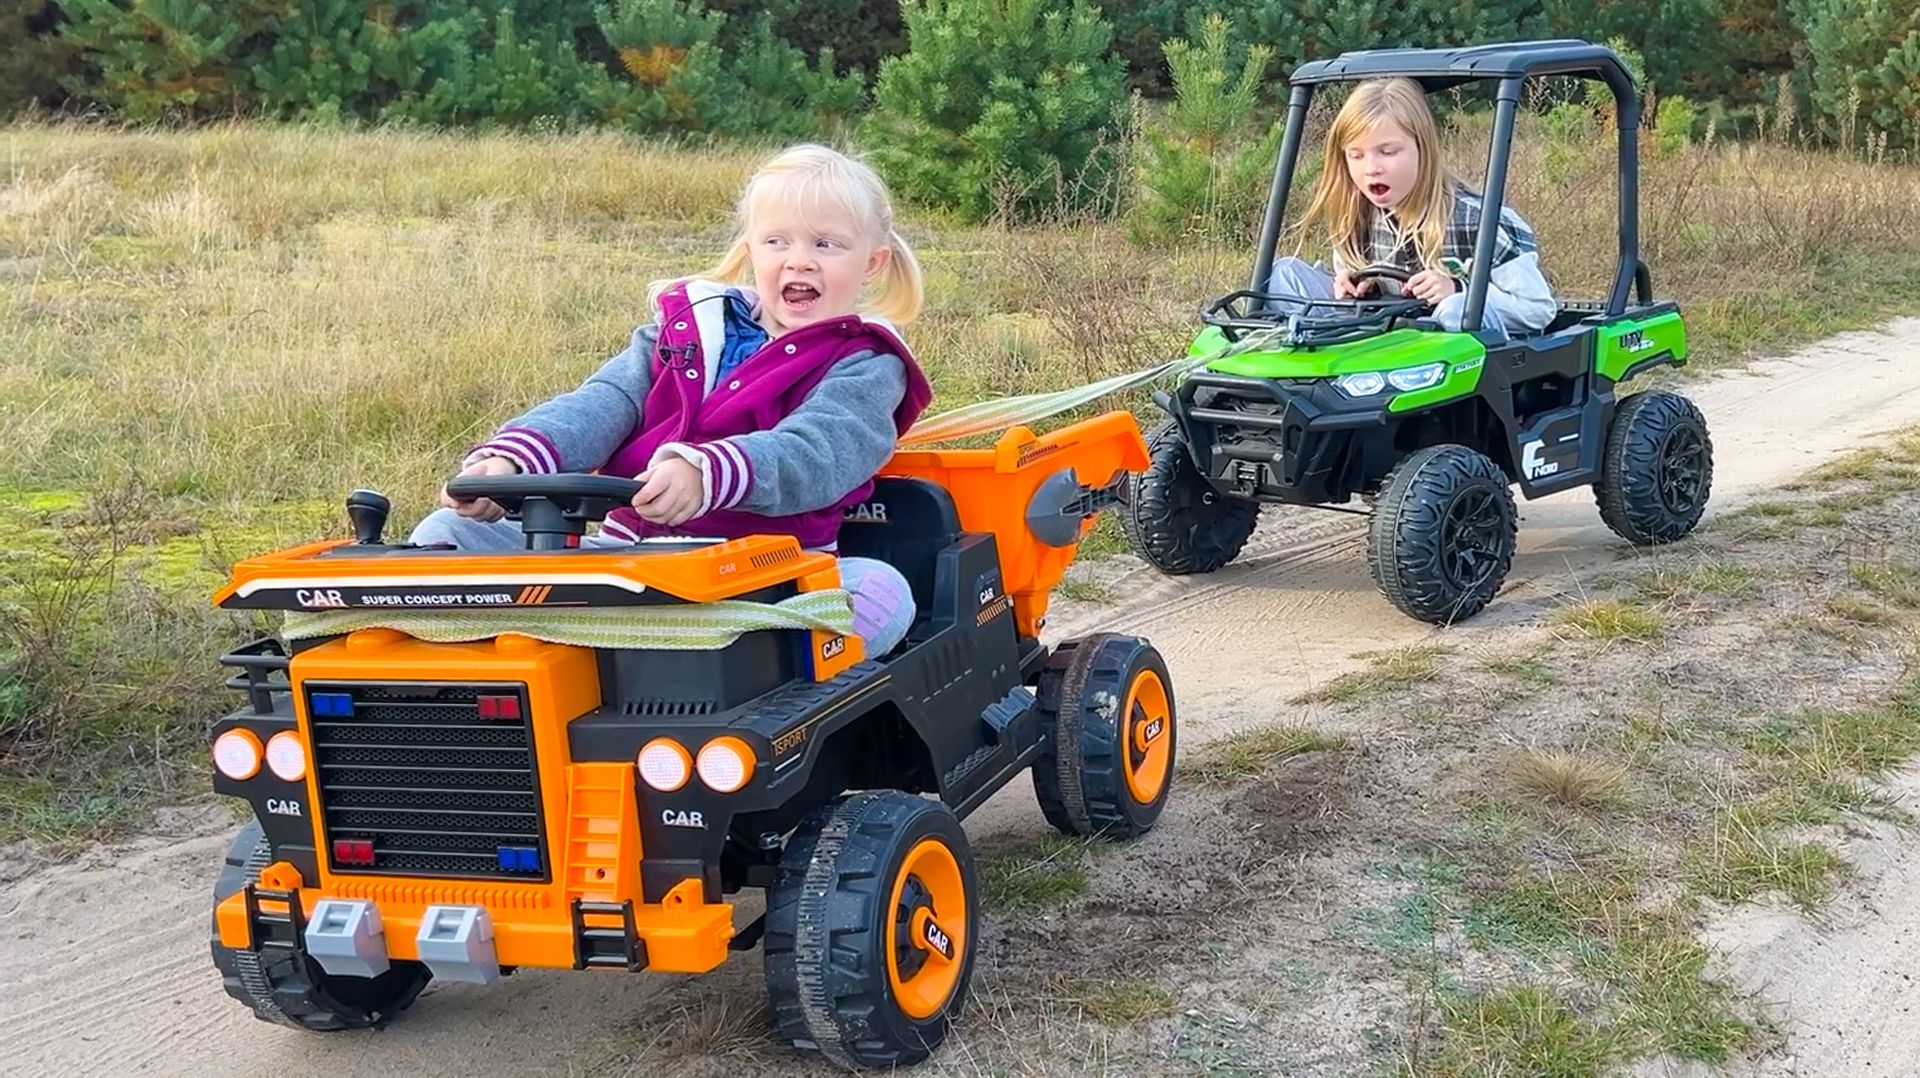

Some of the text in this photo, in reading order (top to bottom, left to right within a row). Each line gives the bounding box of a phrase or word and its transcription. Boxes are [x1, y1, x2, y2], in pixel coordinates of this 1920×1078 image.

[719, 563, 736, 575] CAR
[296, 589, 513, 608] CAR SUPER CONCEPT POWER
[980, 587, 995, 604] CAR
[823, 637, 844, 658] CAR
[1146, 720, 1160, 740] CAR
[266, 798, 302, 816] CAR
[662, 809, 704, 827] CAR
[928, 924, 948, 954] CAR
